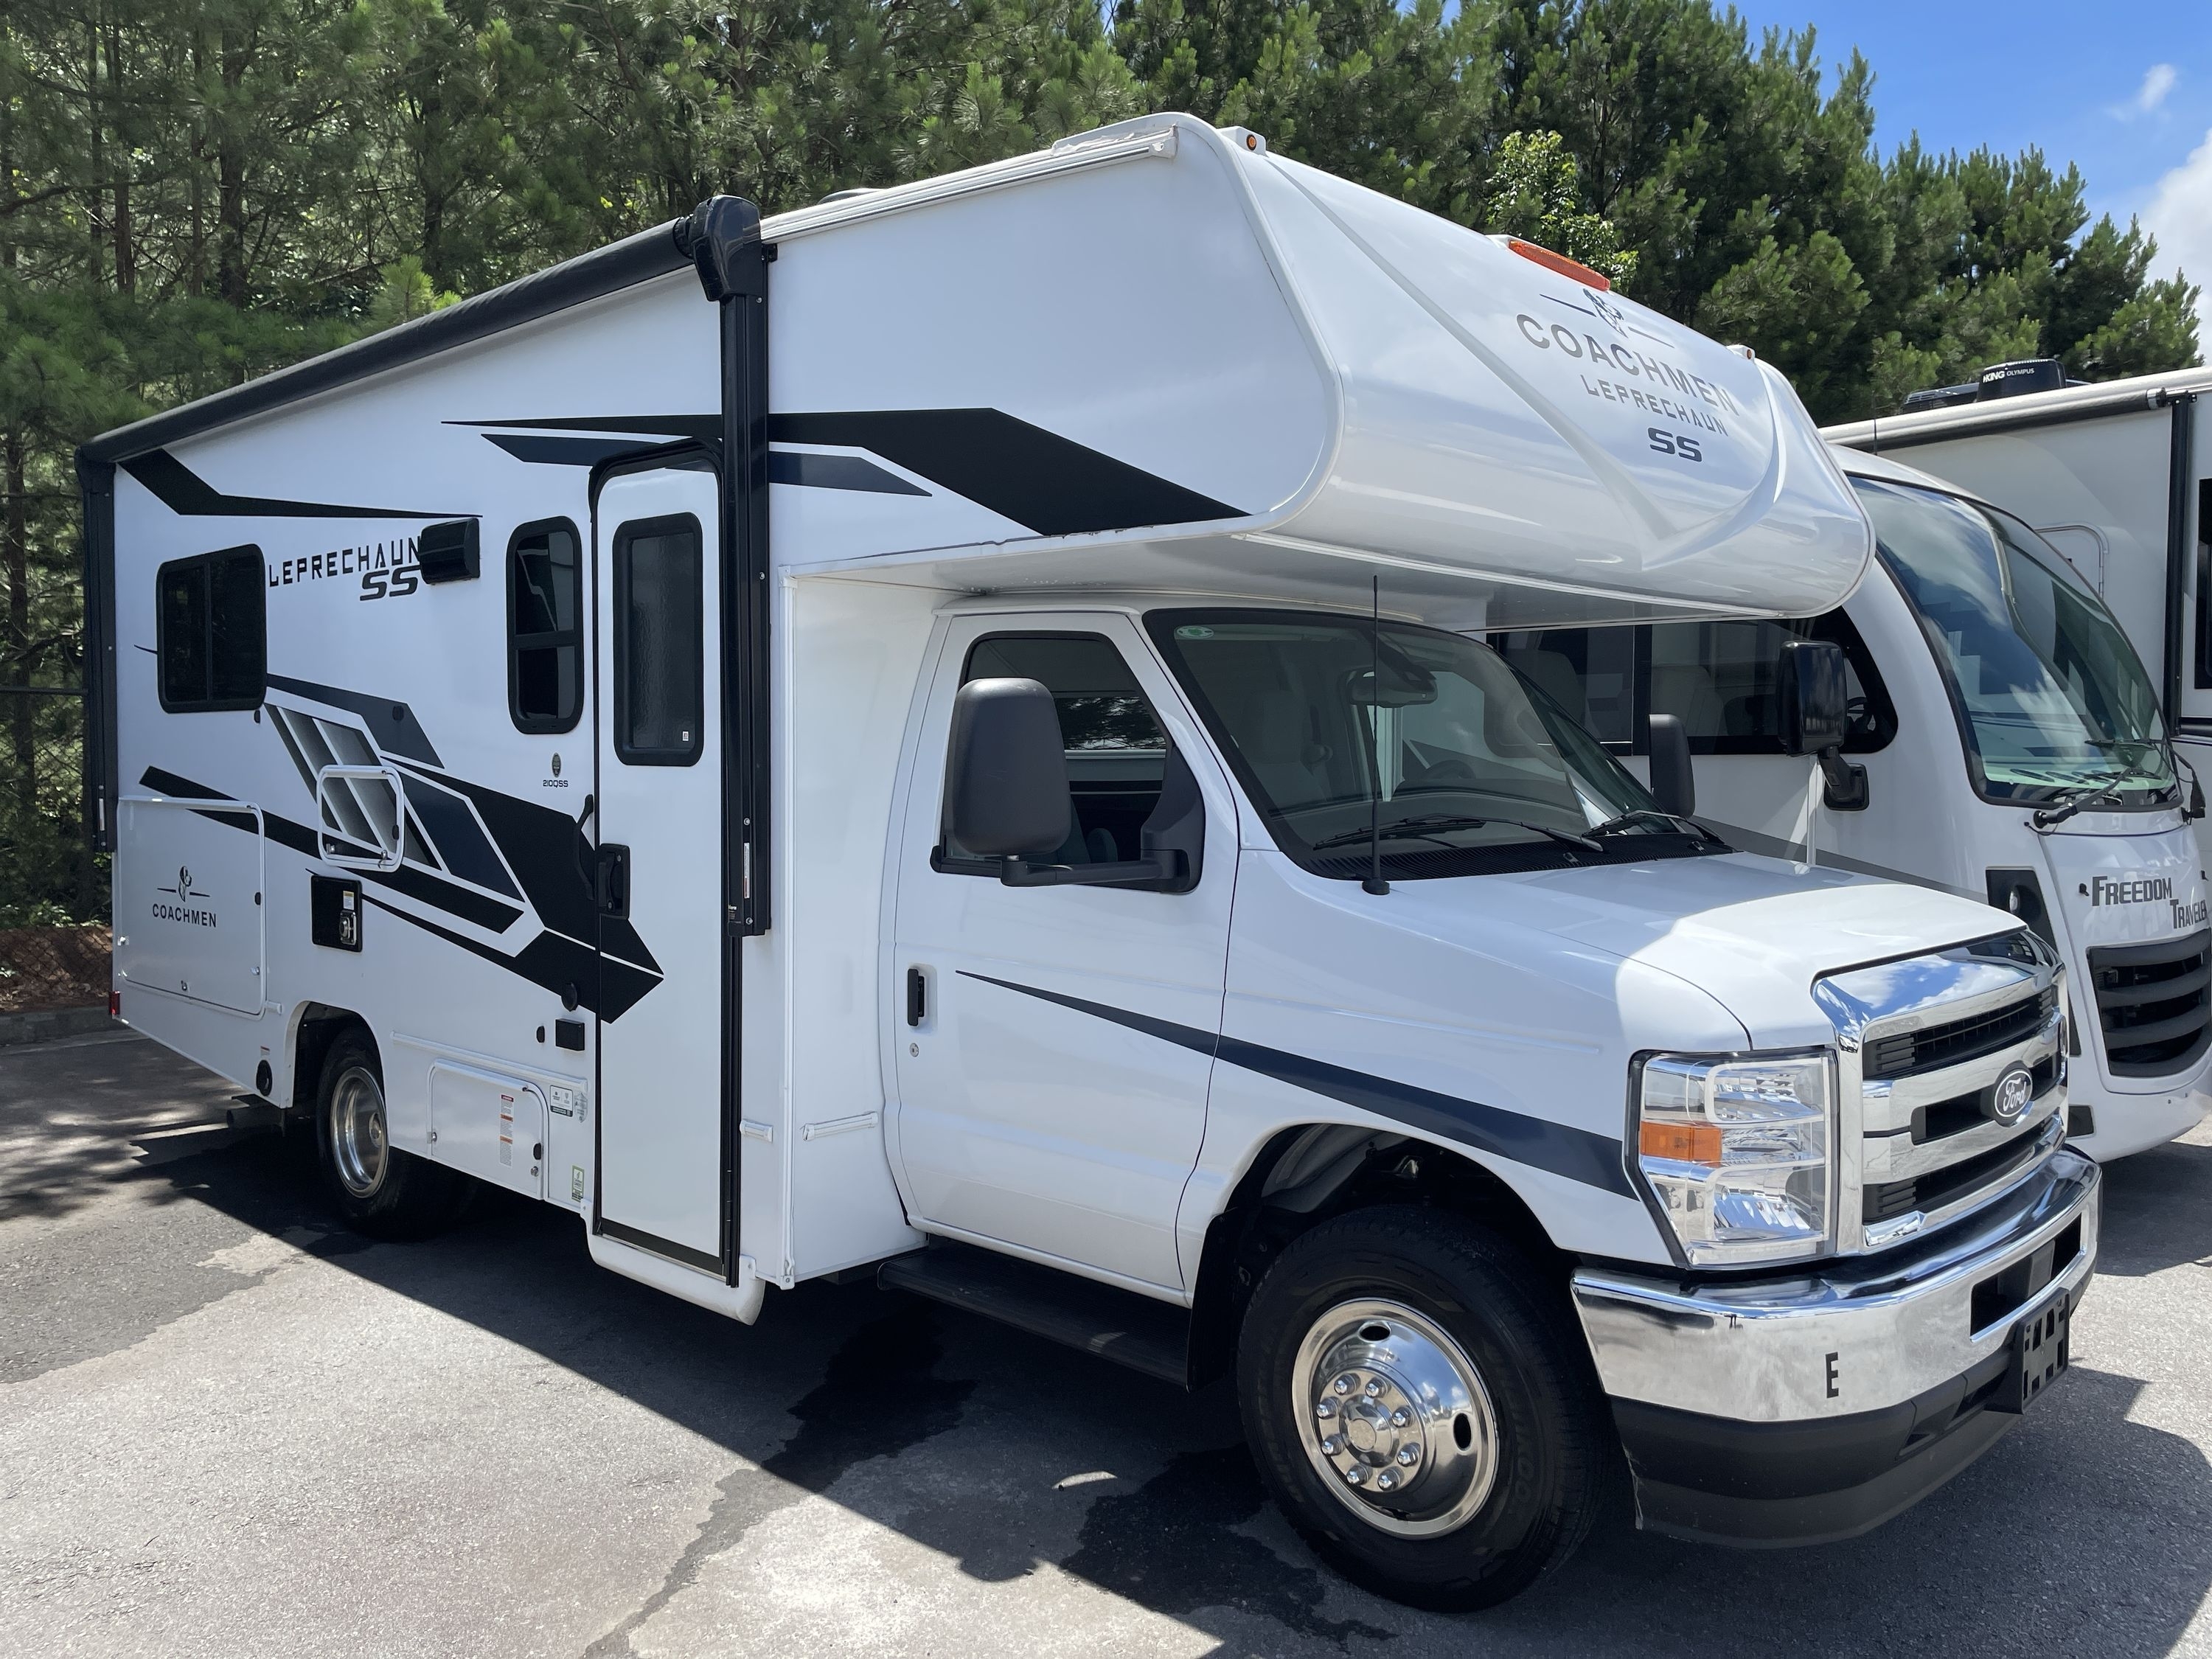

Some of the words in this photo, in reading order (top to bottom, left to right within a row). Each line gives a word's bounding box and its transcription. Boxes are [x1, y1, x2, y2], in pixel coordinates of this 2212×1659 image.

[1516, 313, 1739, 416] COACHMEN
[1986, 370, 2005, 383] KING
[2007, 368, 2034, 377] OLYMPUS
[1580, 374, 1729, 437] LEPRECHAUN
[1648, 428, 1703, 462] SS
[270, 535, 421, 587] LEPRECHAUN
[360, 568, 421, 601] SS
[2092, 875, 2172, 907] FREEDOM
[152, 903, 218, 928] COACHMEN
[2002, 1078, 2028, 1112] Ford
[1825, 1352, 1839, 1398] E
